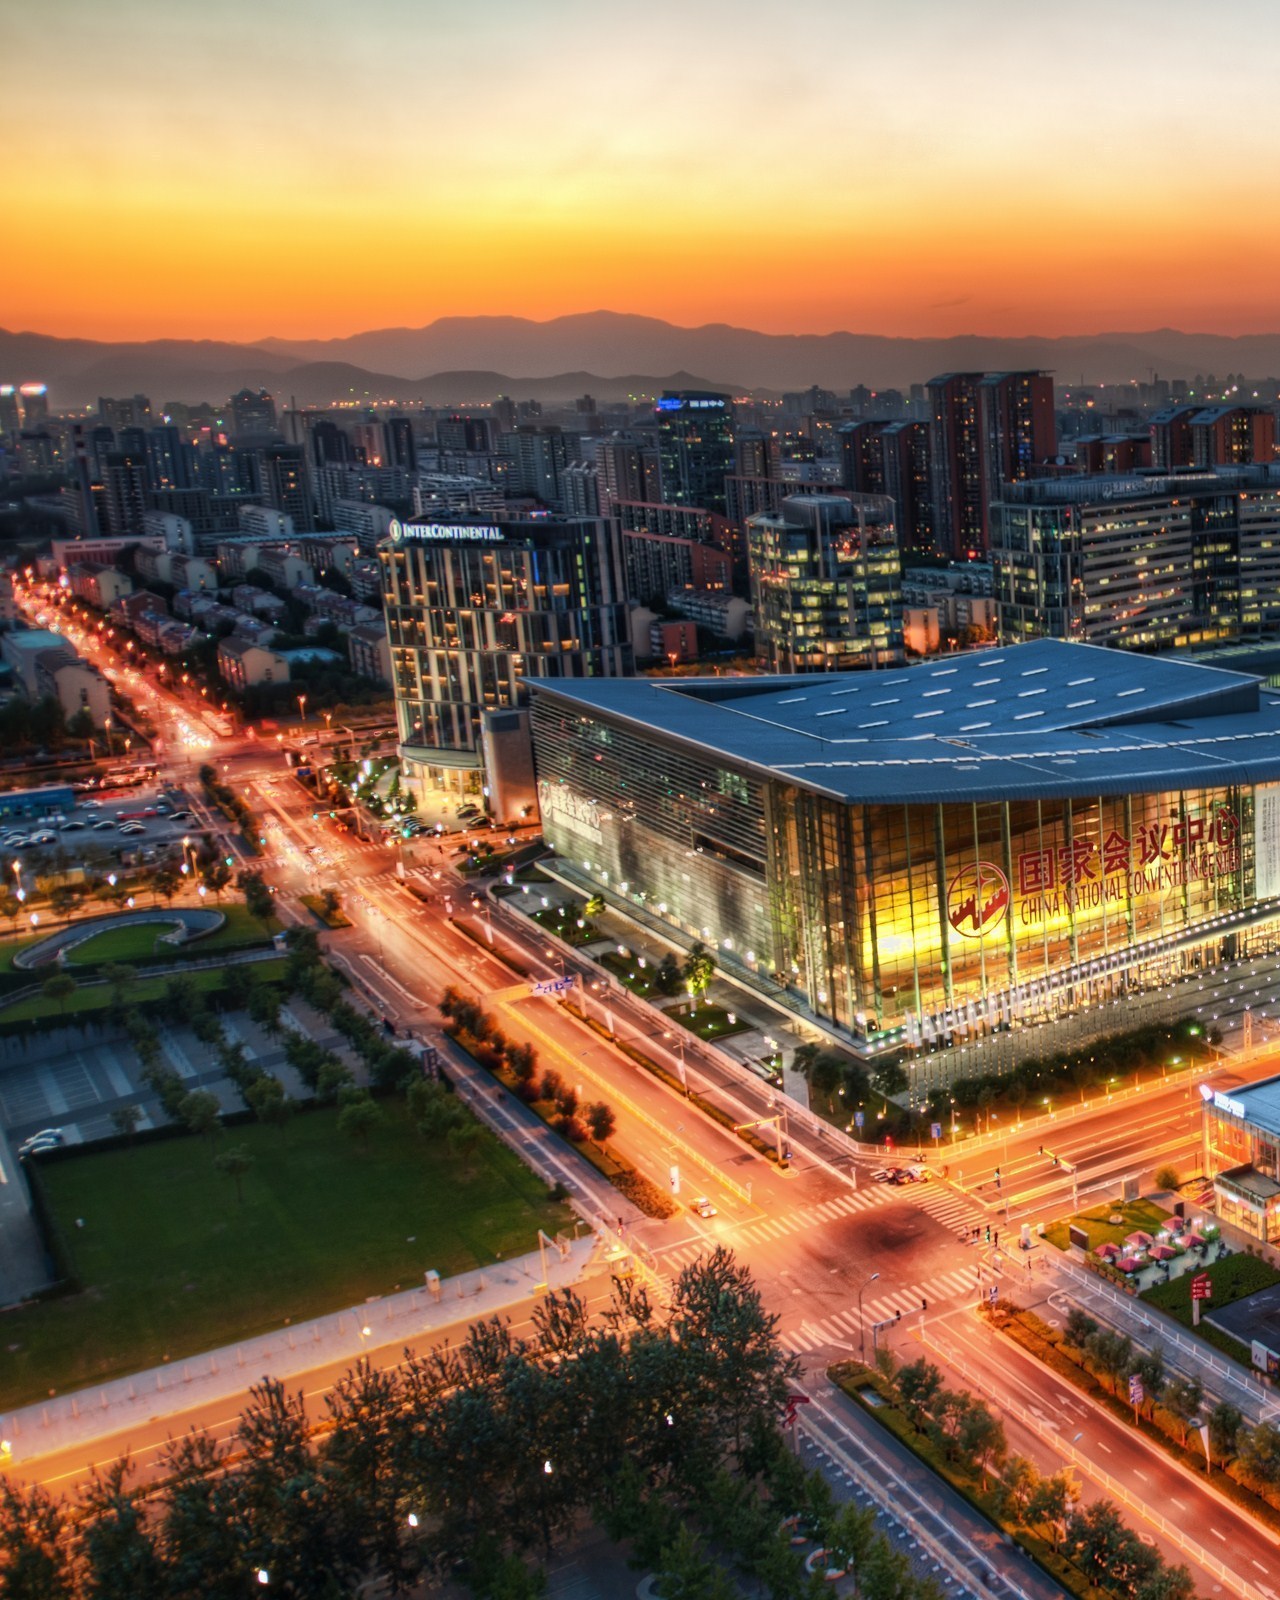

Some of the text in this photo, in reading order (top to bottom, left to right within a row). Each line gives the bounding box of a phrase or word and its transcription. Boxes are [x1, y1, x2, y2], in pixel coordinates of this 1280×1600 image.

[1018, 808, 1240, 896] 国家会议中心
[1021, 847, 1240, 925] CHINA NATIONAL CONVENTION CENTER
